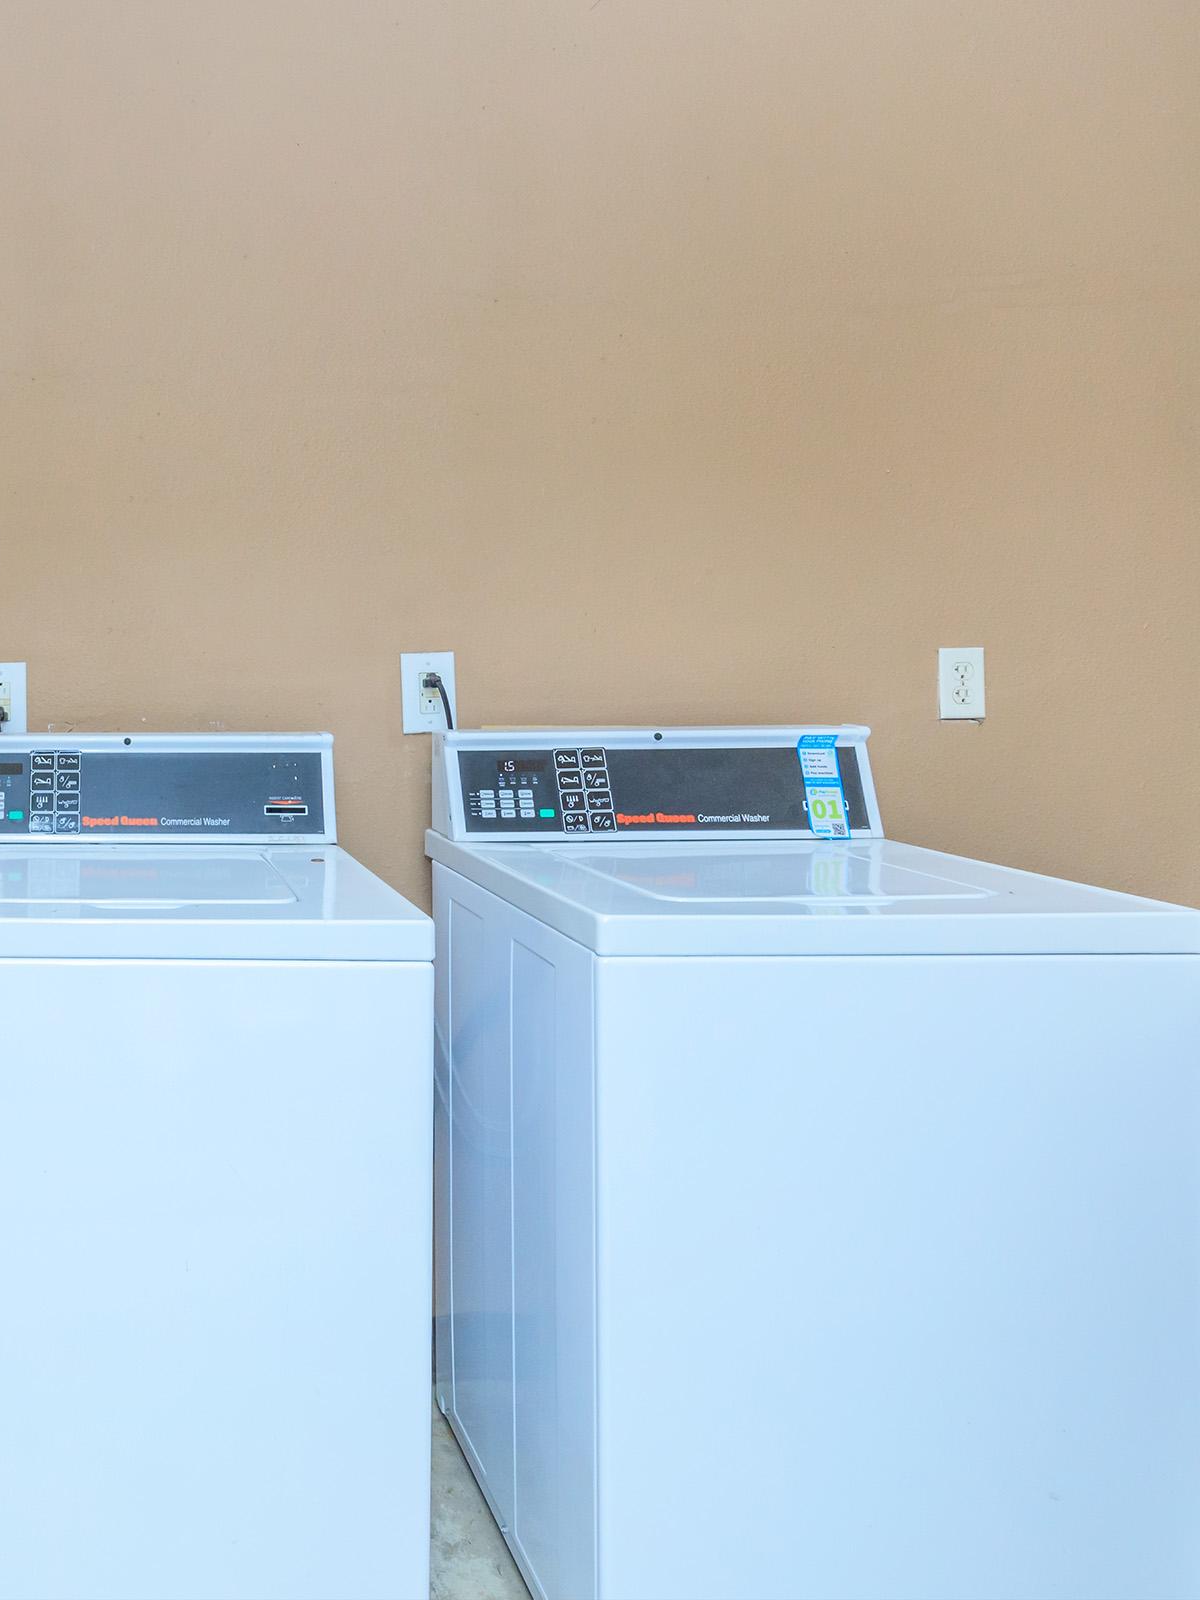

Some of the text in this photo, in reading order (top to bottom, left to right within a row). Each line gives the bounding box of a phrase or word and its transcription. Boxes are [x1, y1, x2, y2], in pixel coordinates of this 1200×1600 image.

[812, 799, 843, 820] 01
[82, 815, 231, 827] Speed Queen Commercial Washer
[616, 812, 770, 825] Speed Queen Commercial Washer
